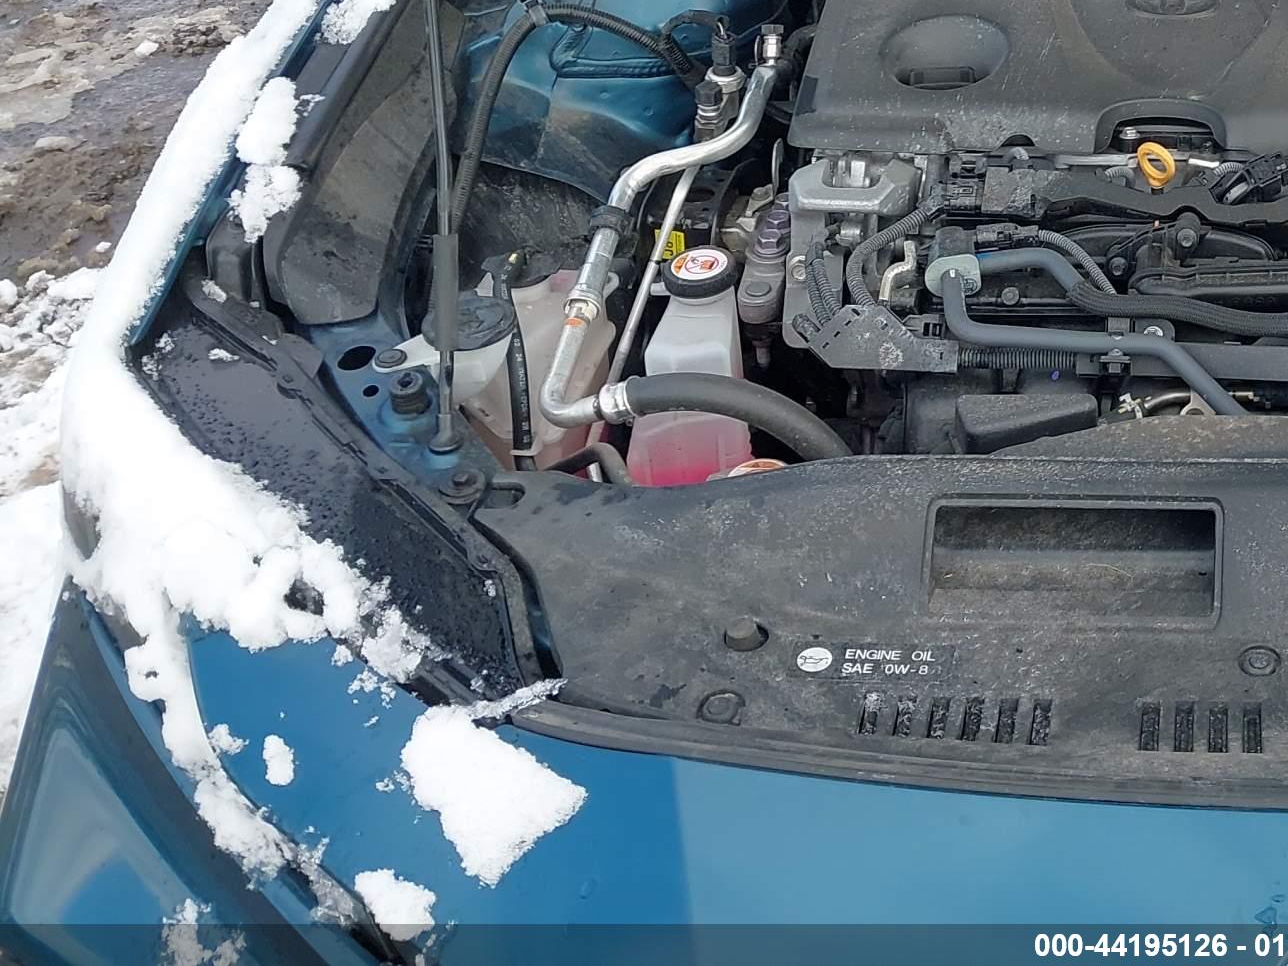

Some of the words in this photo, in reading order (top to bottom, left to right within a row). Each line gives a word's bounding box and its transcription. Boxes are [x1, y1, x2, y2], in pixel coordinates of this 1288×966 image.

[845, 648, 902, 661] ENGINE
[911, 650, 936, 662] OIL
[841, 662, 874, 674] SAE
[884, 664, 929, 676] 0W-8
